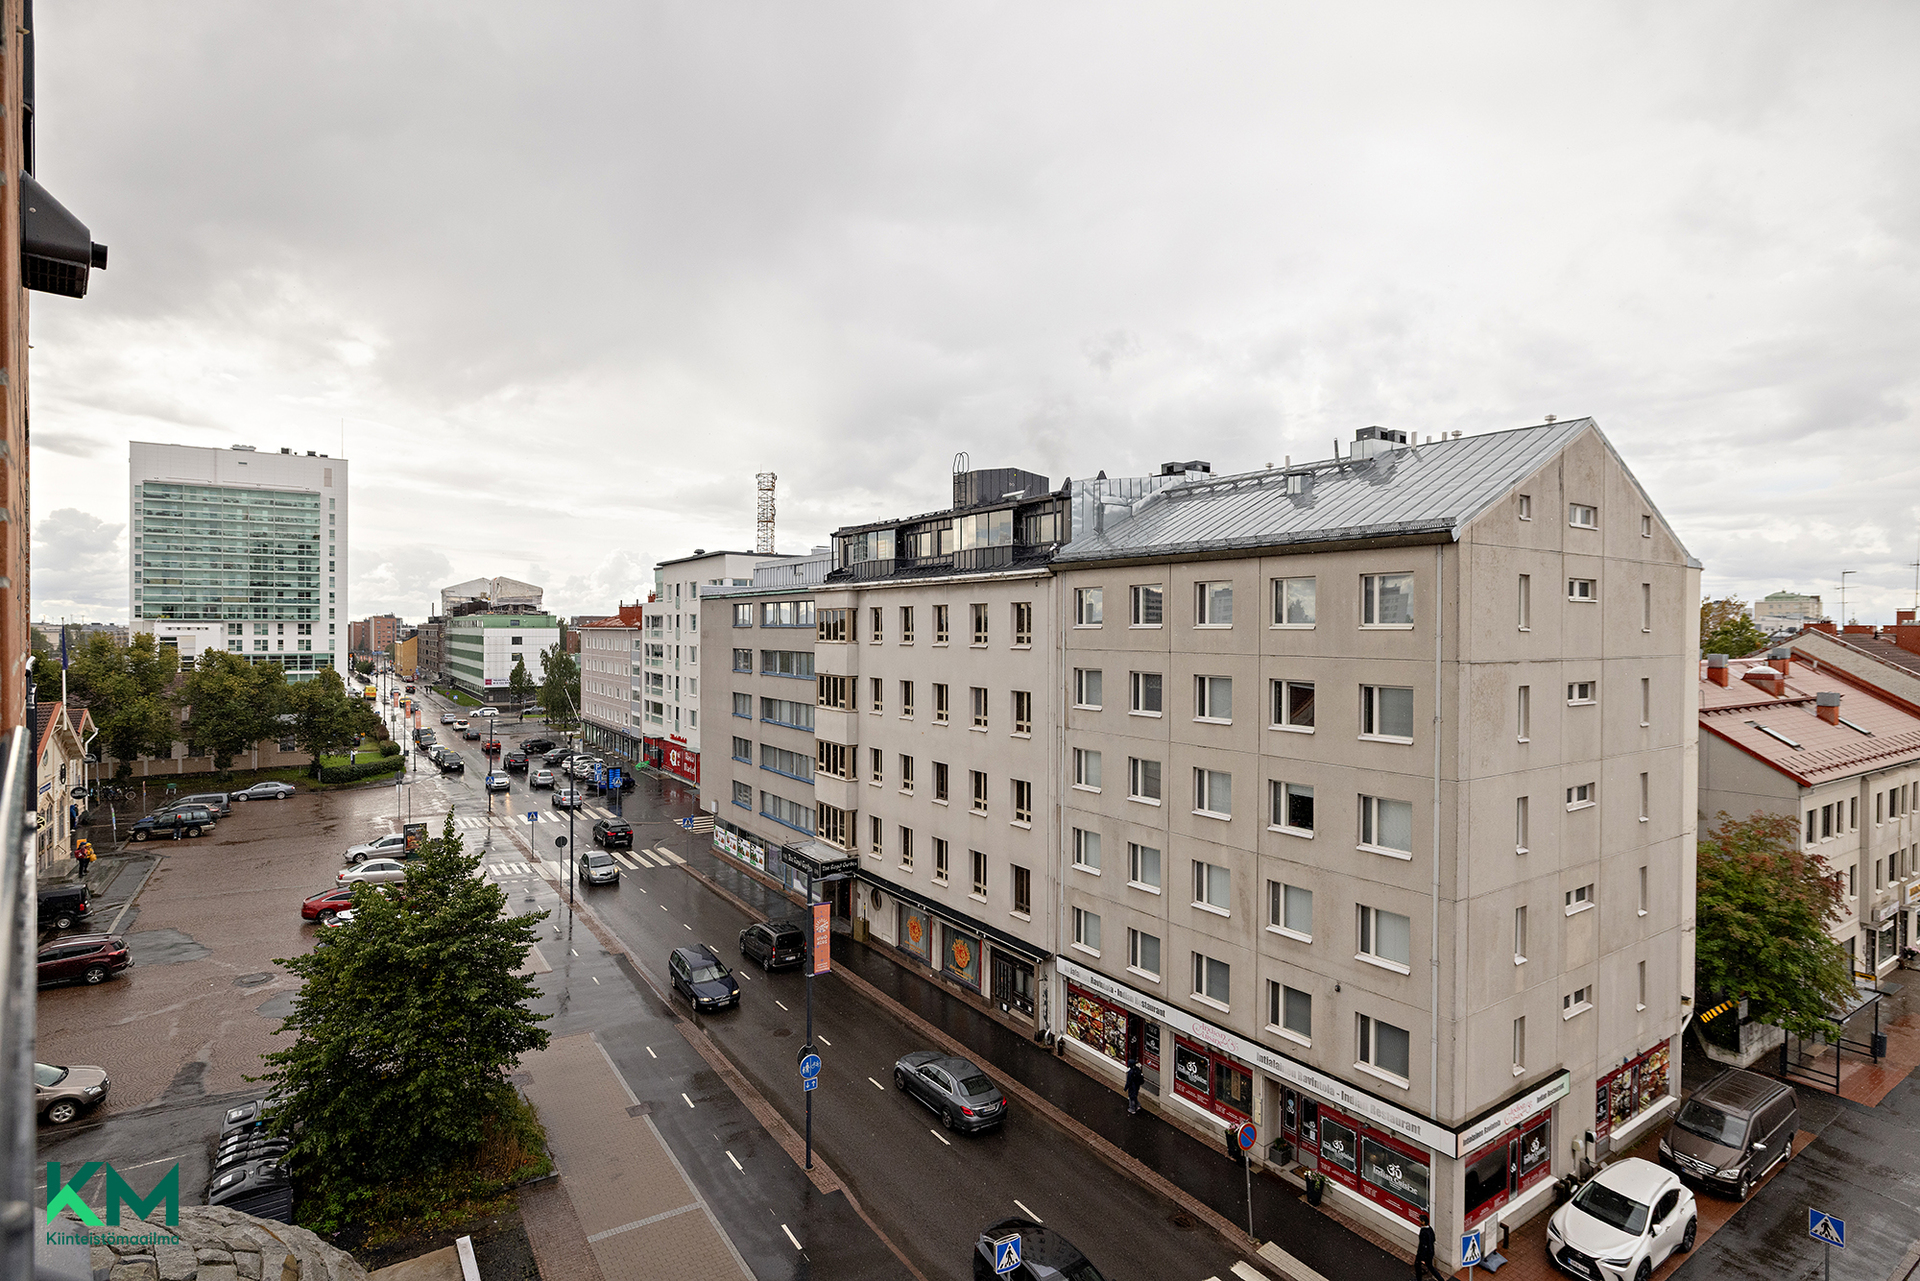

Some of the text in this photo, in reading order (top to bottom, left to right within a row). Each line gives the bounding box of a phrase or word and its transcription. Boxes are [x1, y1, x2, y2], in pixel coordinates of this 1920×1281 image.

[1298, 1070, 1335, 1096] Ravintola
[1370, 1103, 1421, 1136] Restaurant
[1373, 1164, 1393, 1182] Indian
[1394, 1177, 1418, 1195] Cuisine
